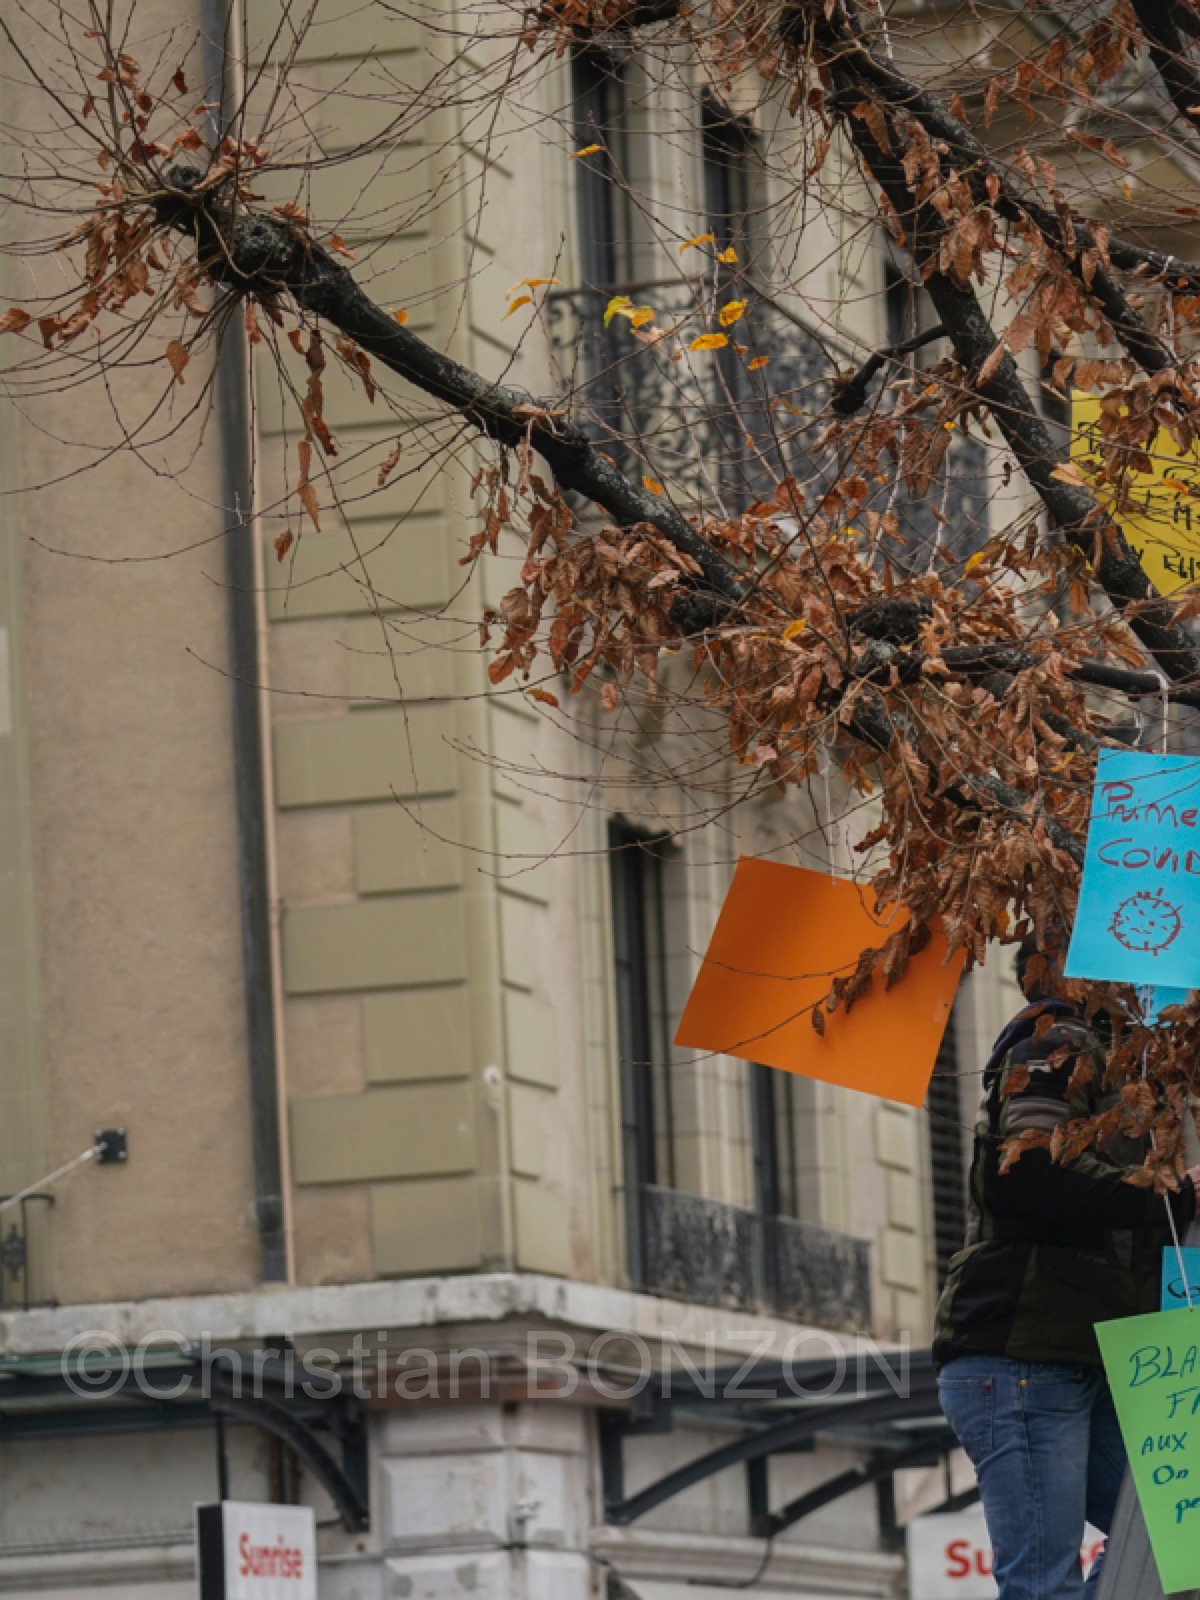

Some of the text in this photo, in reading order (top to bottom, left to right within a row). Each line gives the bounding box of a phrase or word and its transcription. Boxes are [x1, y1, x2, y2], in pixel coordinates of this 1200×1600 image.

[1101, 781, 1200, 828] Prime
[1141, 1431, 1188, 1456] AUX
[1152, 1464, 1189, 1485] On
[238, 1531, 303, 1578] Sunrise
